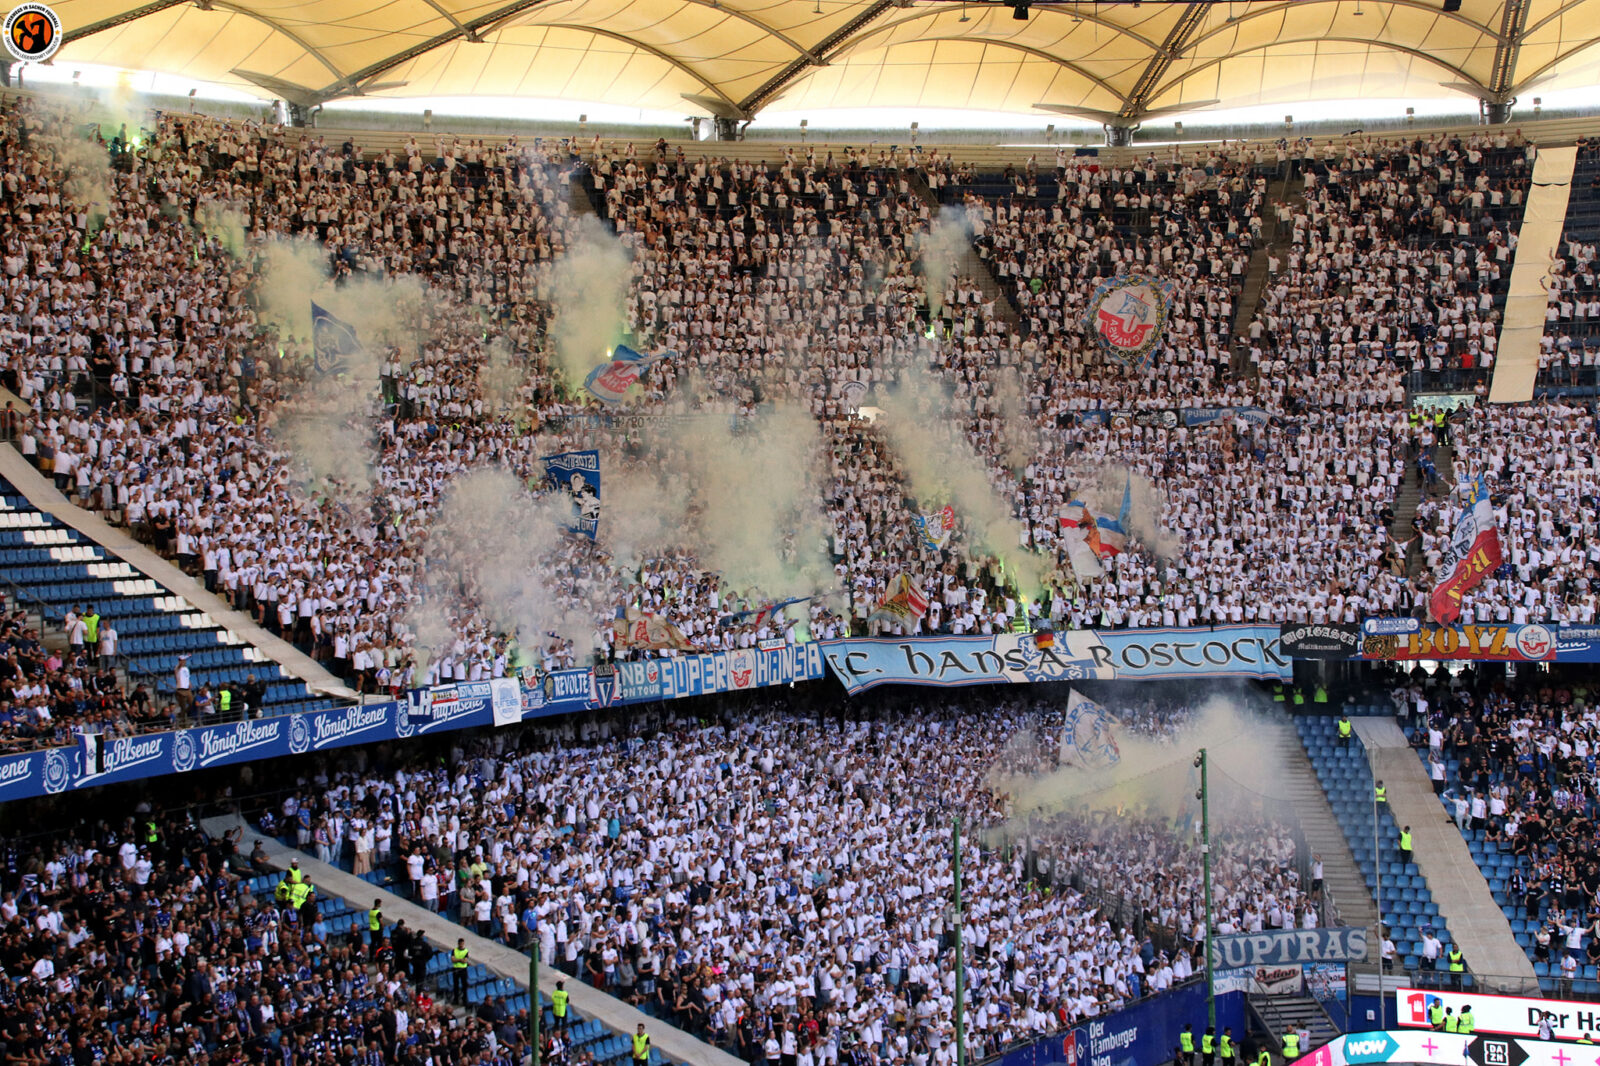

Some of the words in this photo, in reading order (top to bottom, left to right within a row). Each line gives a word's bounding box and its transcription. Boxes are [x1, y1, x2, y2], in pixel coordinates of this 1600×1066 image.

[1087, 636, 1288, 671] ROSTOCK
[1408, 625, 1510, 656] BOYZ
[661, 653, 727, 698] SUPER
[757, 641, 823, 686] HANSA
[554, 673, 589, 696] REVOLTE
[623, 687, 636, 698] ON
[637, 684, 660, 696] TOUR
[1206, 929, 1368, 969] SUPTRAS
[1089, 1021, 1105, 1039] Der
[1090, 1027, 1138, 1056] Hamburger
[1348, 1040, 1388, 1056] WOW
